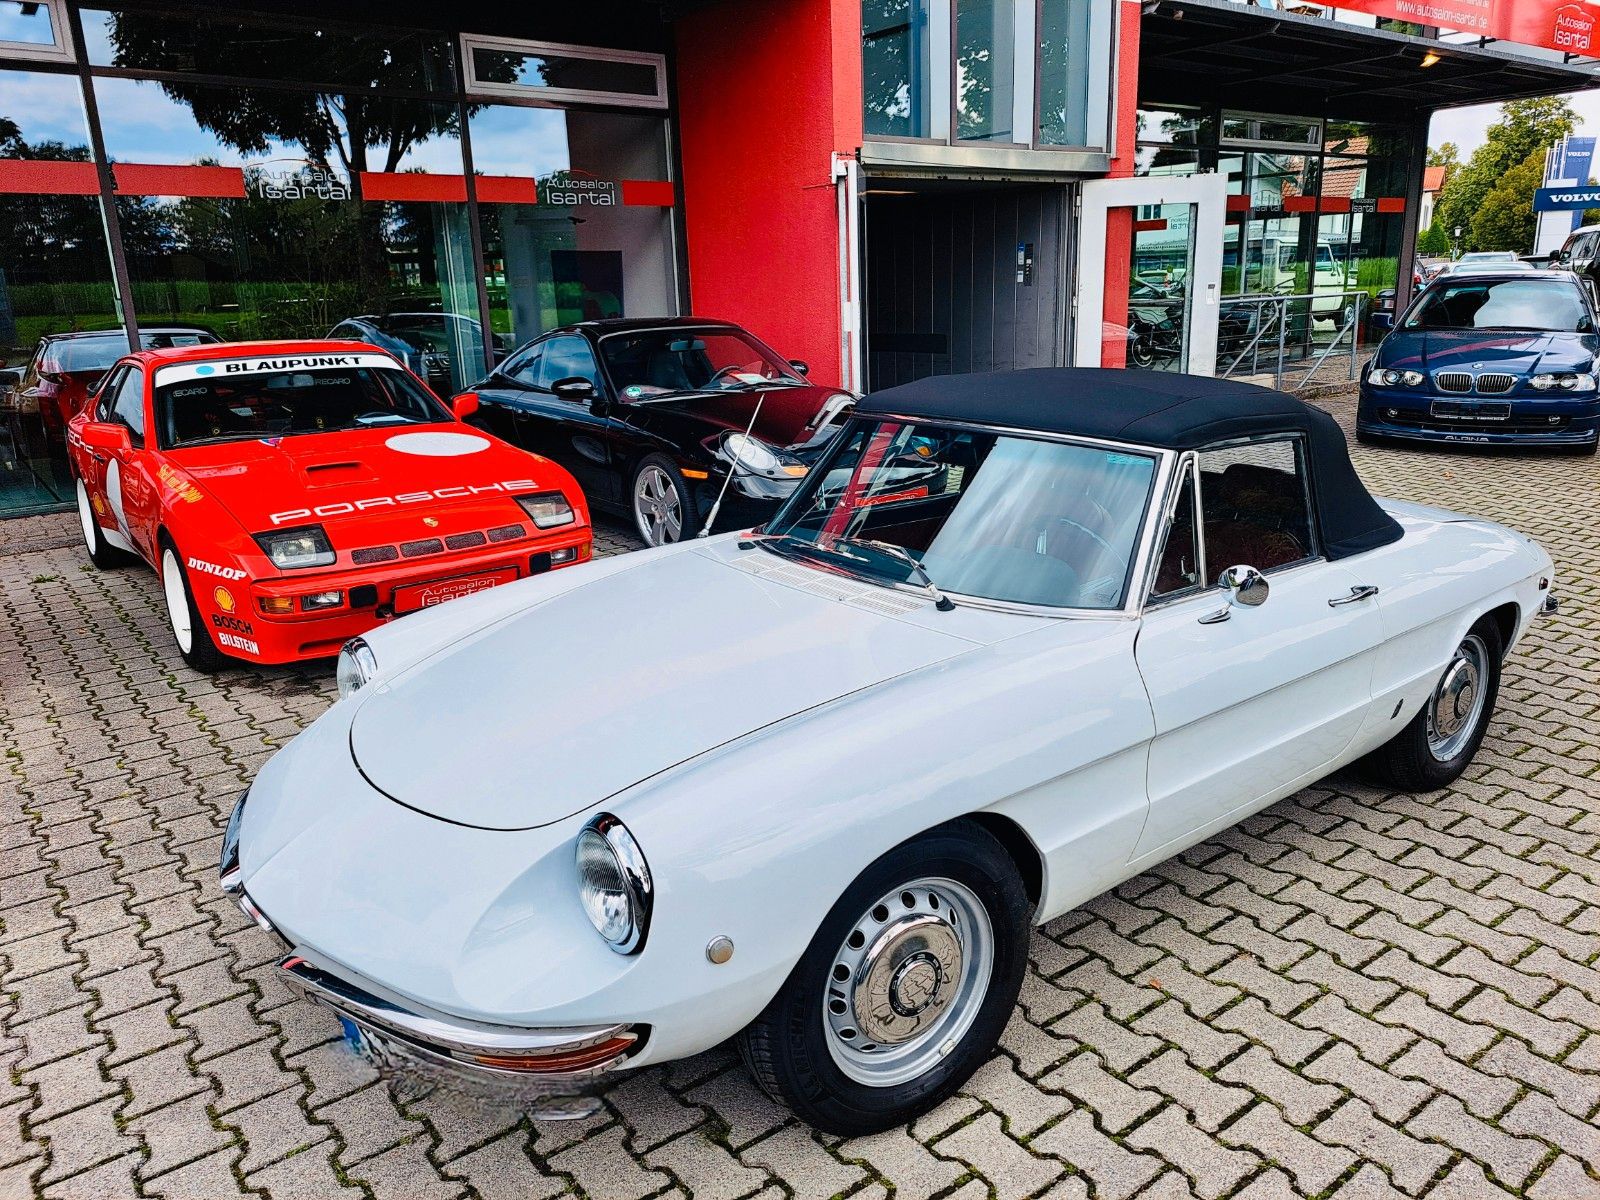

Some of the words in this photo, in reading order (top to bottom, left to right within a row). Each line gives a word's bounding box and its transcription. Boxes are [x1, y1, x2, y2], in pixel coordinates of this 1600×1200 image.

[1556, 13, 1593, 31] Autosalon
[1554, 26, 1592, 50] Isartal
[260, 168, 349, 181] Autosalon
[260, 181, 352, 200] Isartal
[546, 178, 614, 190] Autosalon
[546, 188, 616, 206] Isartal
[225, 356, 362, 373] BLAUPUNKT
[315, 377, 351, 385] RECARO
[269, 479, 540, 525] PORSCHE
[187, 557, 248, 581] DUNLOP
[424, 579, 495, 596] Autosalon
[212, 613, 254, 635] BOSCH
[218, 632, 260, 655] BILSTEIN
